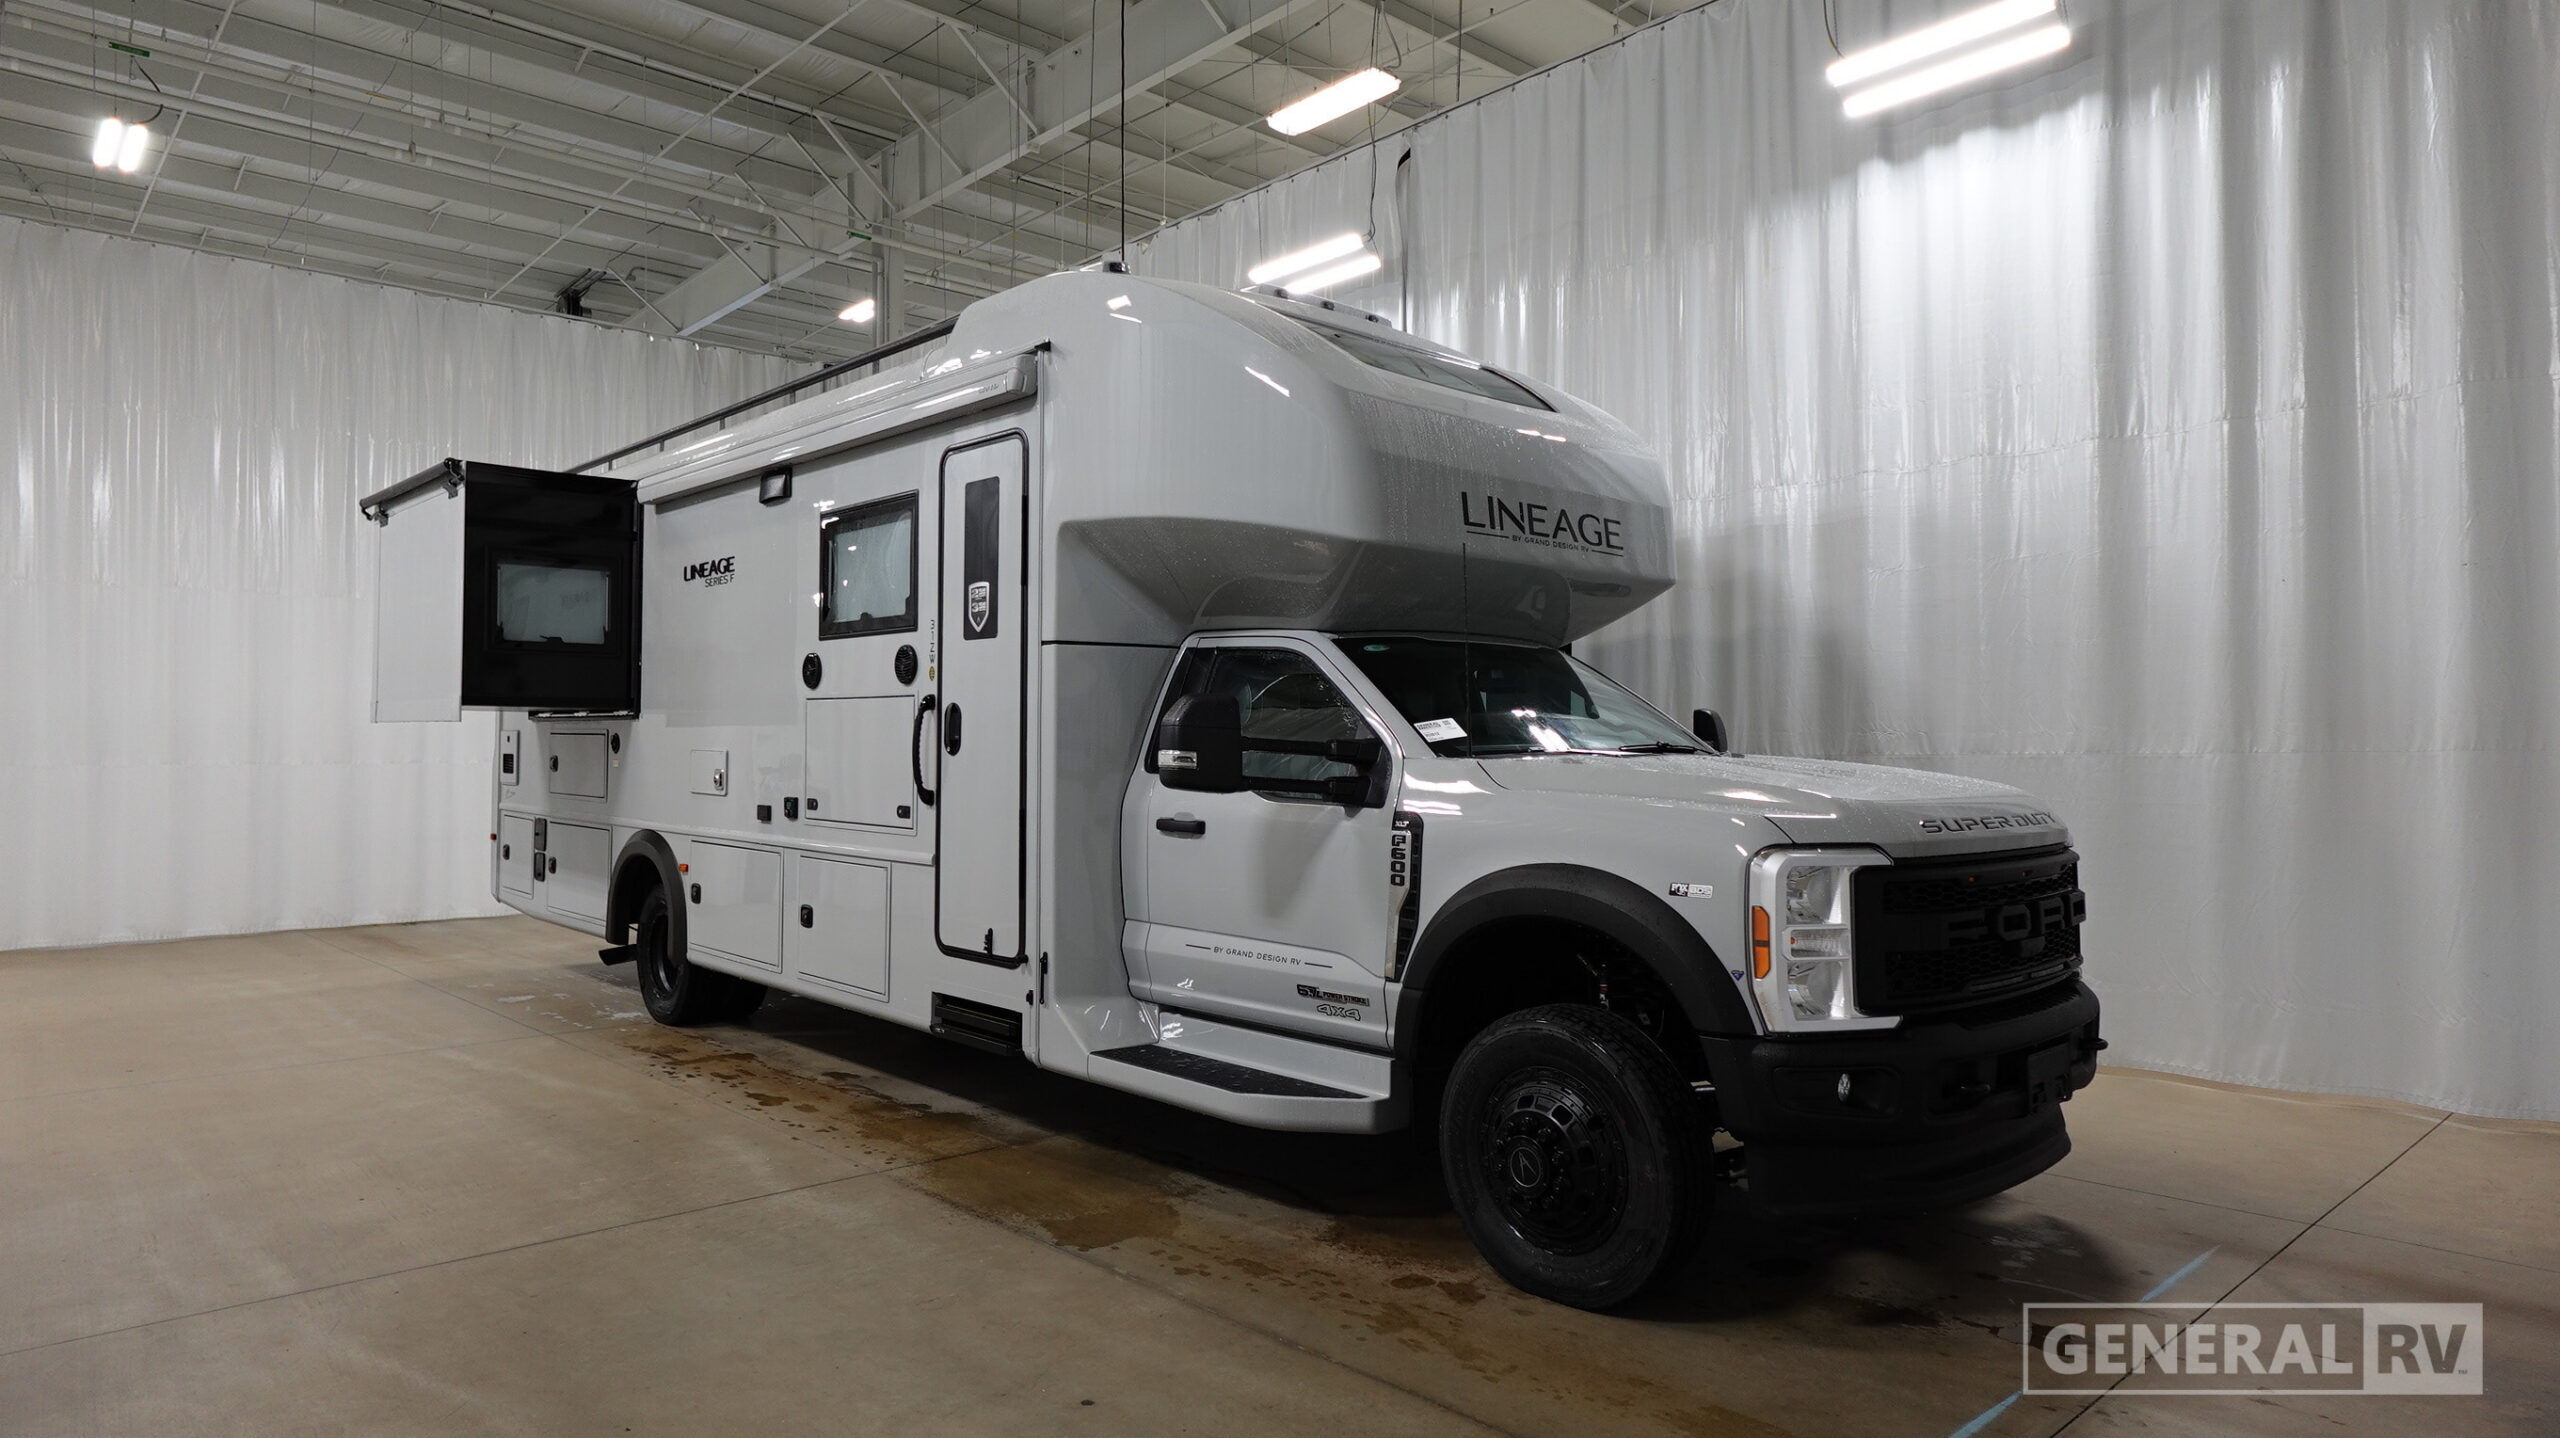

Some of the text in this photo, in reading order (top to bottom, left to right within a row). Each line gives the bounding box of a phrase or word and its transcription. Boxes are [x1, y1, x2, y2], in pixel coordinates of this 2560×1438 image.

[1461, 491, 1624, 550] LINEAGE
[1512, 534, 1521, 542] BY
[1524, 536, 1550, 547] GRAND
[1552, 541, 1579, 551] DESIGN
[683, 556, 735, 582] LINEAGE
[704, 573, 735, 588] SERIES F
[1395, 820, 1409, 828] XLT
[1921, 812, 2056, 834] SUPER DUTY
[1390, 833, 1406, 887] F600
[1940, 889, 2086, 951] FORD
[1225, 948, 1254, 958] GRAND
[1256, 952, 1288, 964] DESIGN
[1290, 957, 1302, 966] RV
